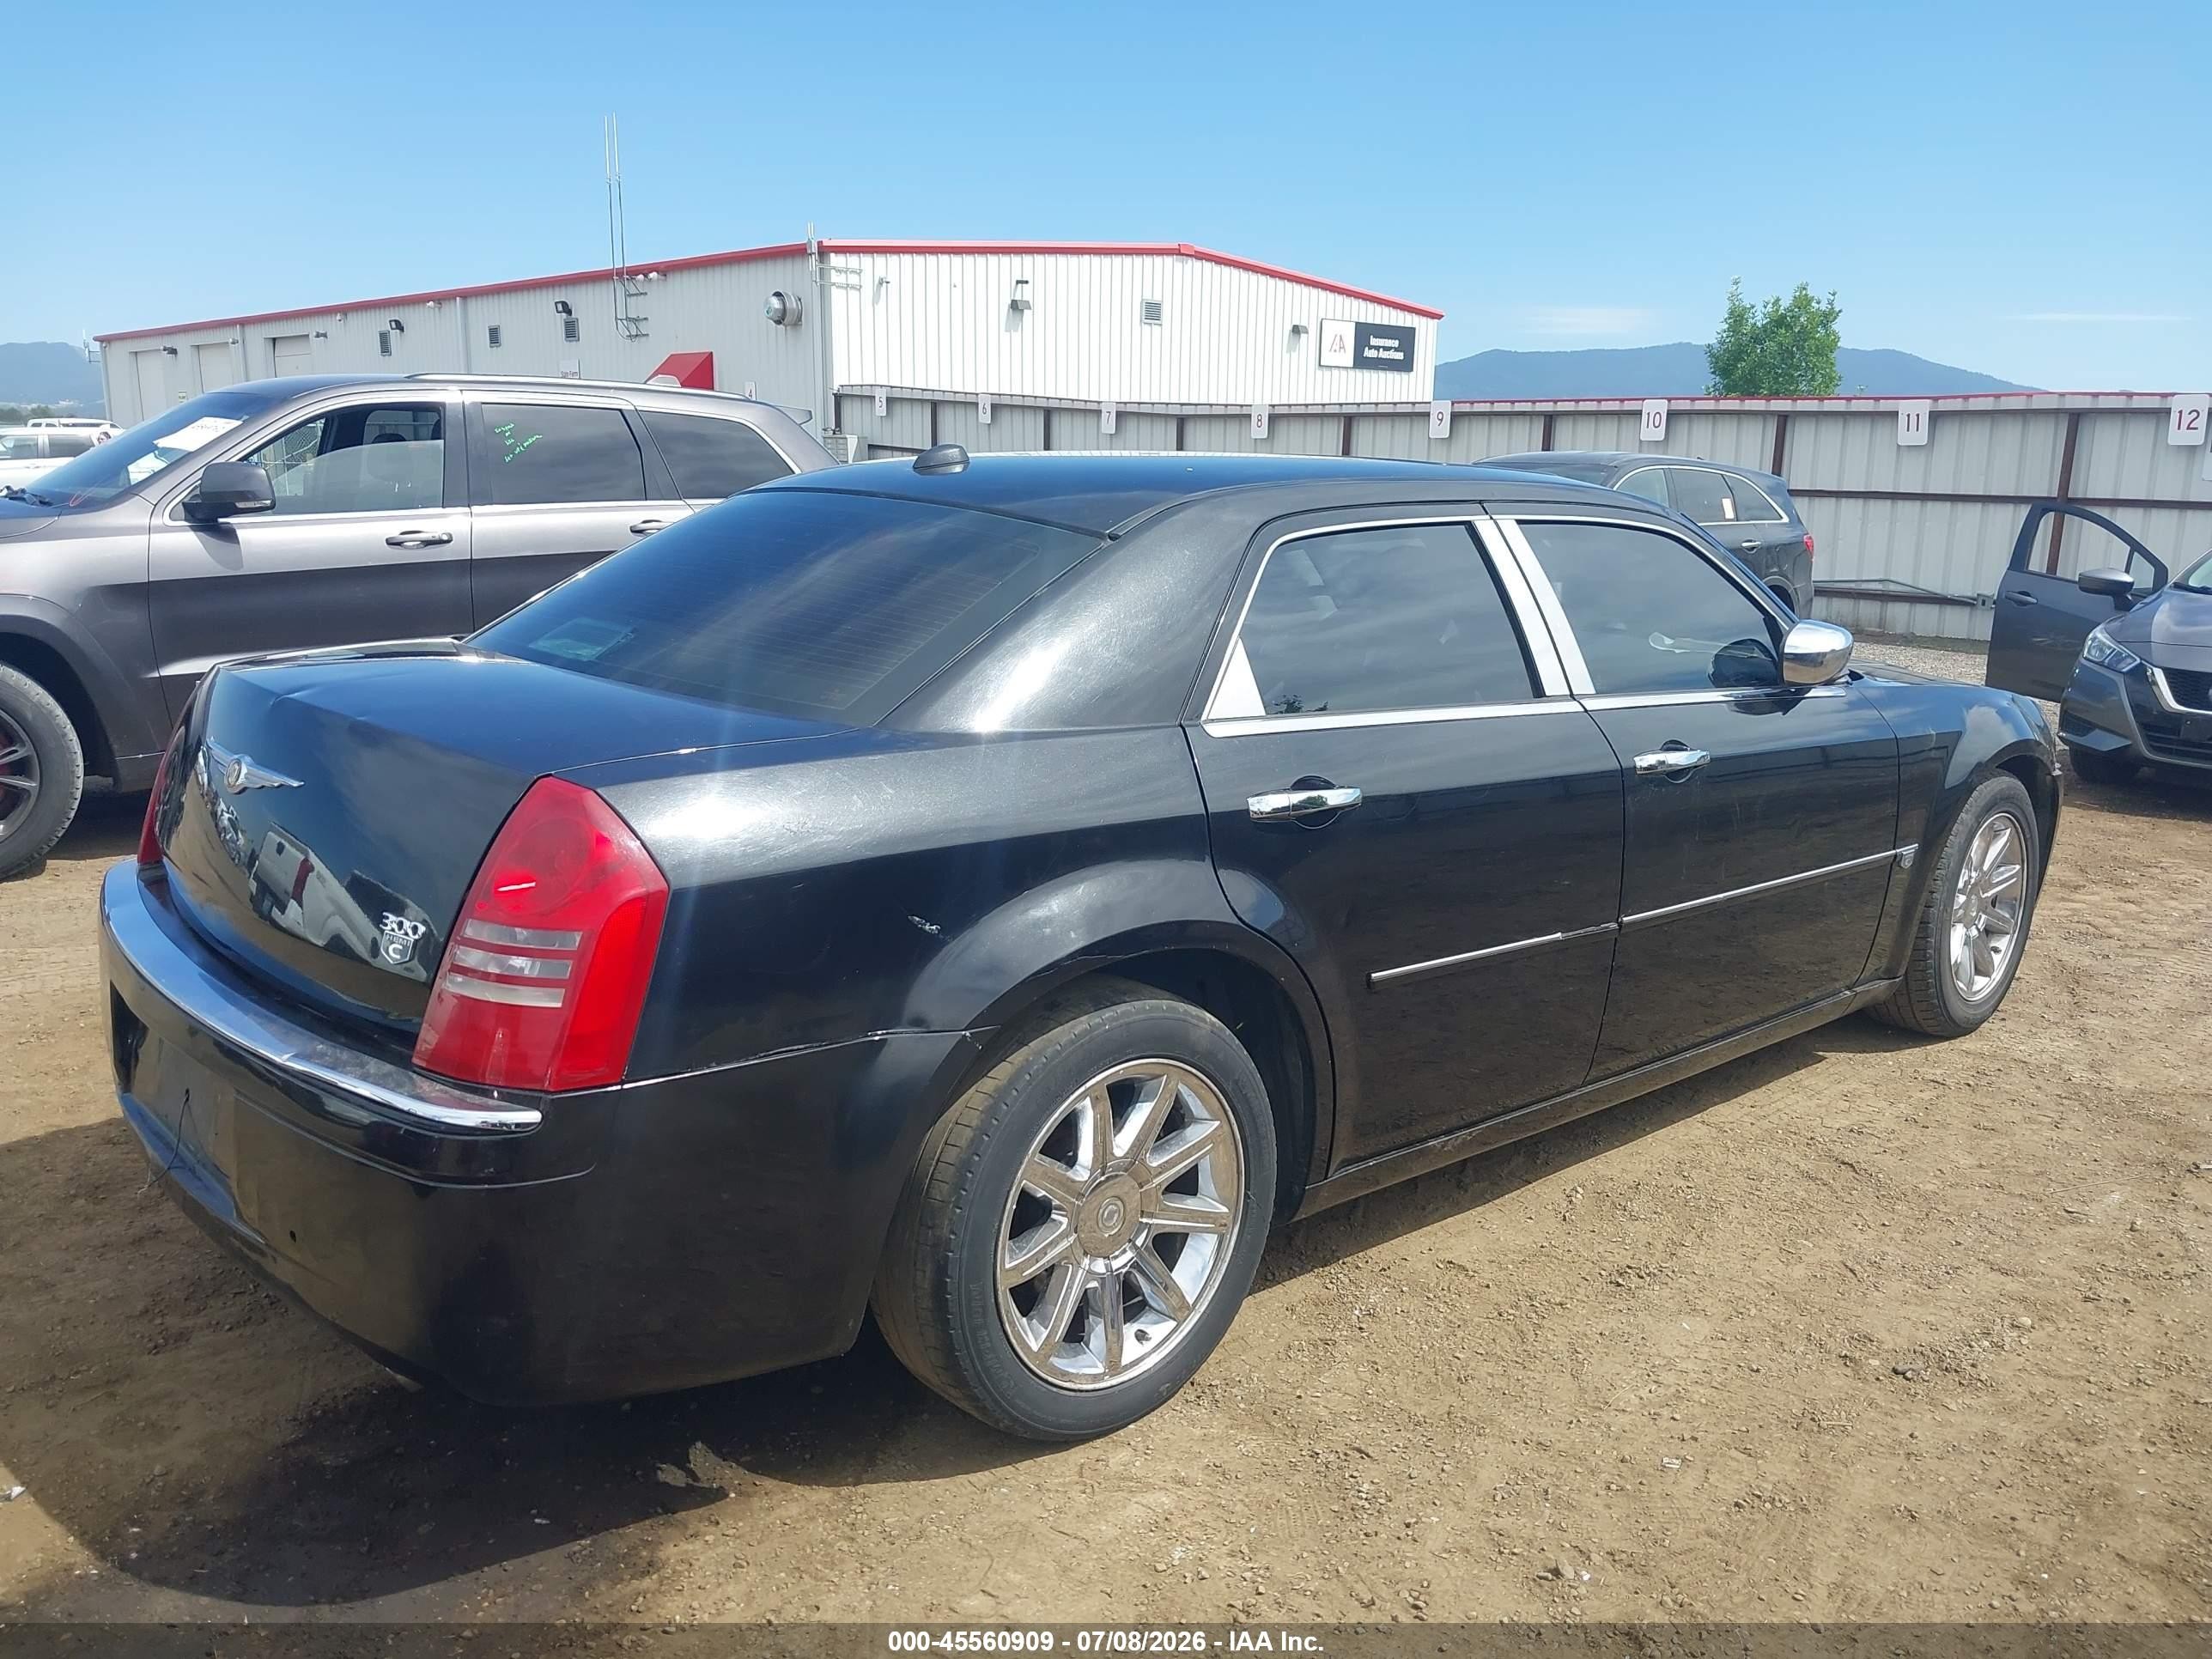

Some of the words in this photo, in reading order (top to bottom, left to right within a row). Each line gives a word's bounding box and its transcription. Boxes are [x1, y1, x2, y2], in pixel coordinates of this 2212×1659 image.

[1370, 335, 1400, 348] Insurance
[1363, 346, 1378, 358] Auto
[1378, 348, 1405, 360] Auctions
[878, 397, 884, 409] 5
[981, 403, 988, 415] 6
[1105, 411, 1112, 424] 7
[1256, 414, 1263, 428] 8
[1437, 411, 1444, 427] 9
[1646, 411, 1662, 428] 10
[1906, 413, 1920, 432] 11
[2177, 409, 2201, 430] 12
[380, 912, 426, 939] 300
[386, 933, 411, 946] HEMI
[388, 944, 403, 959] C
